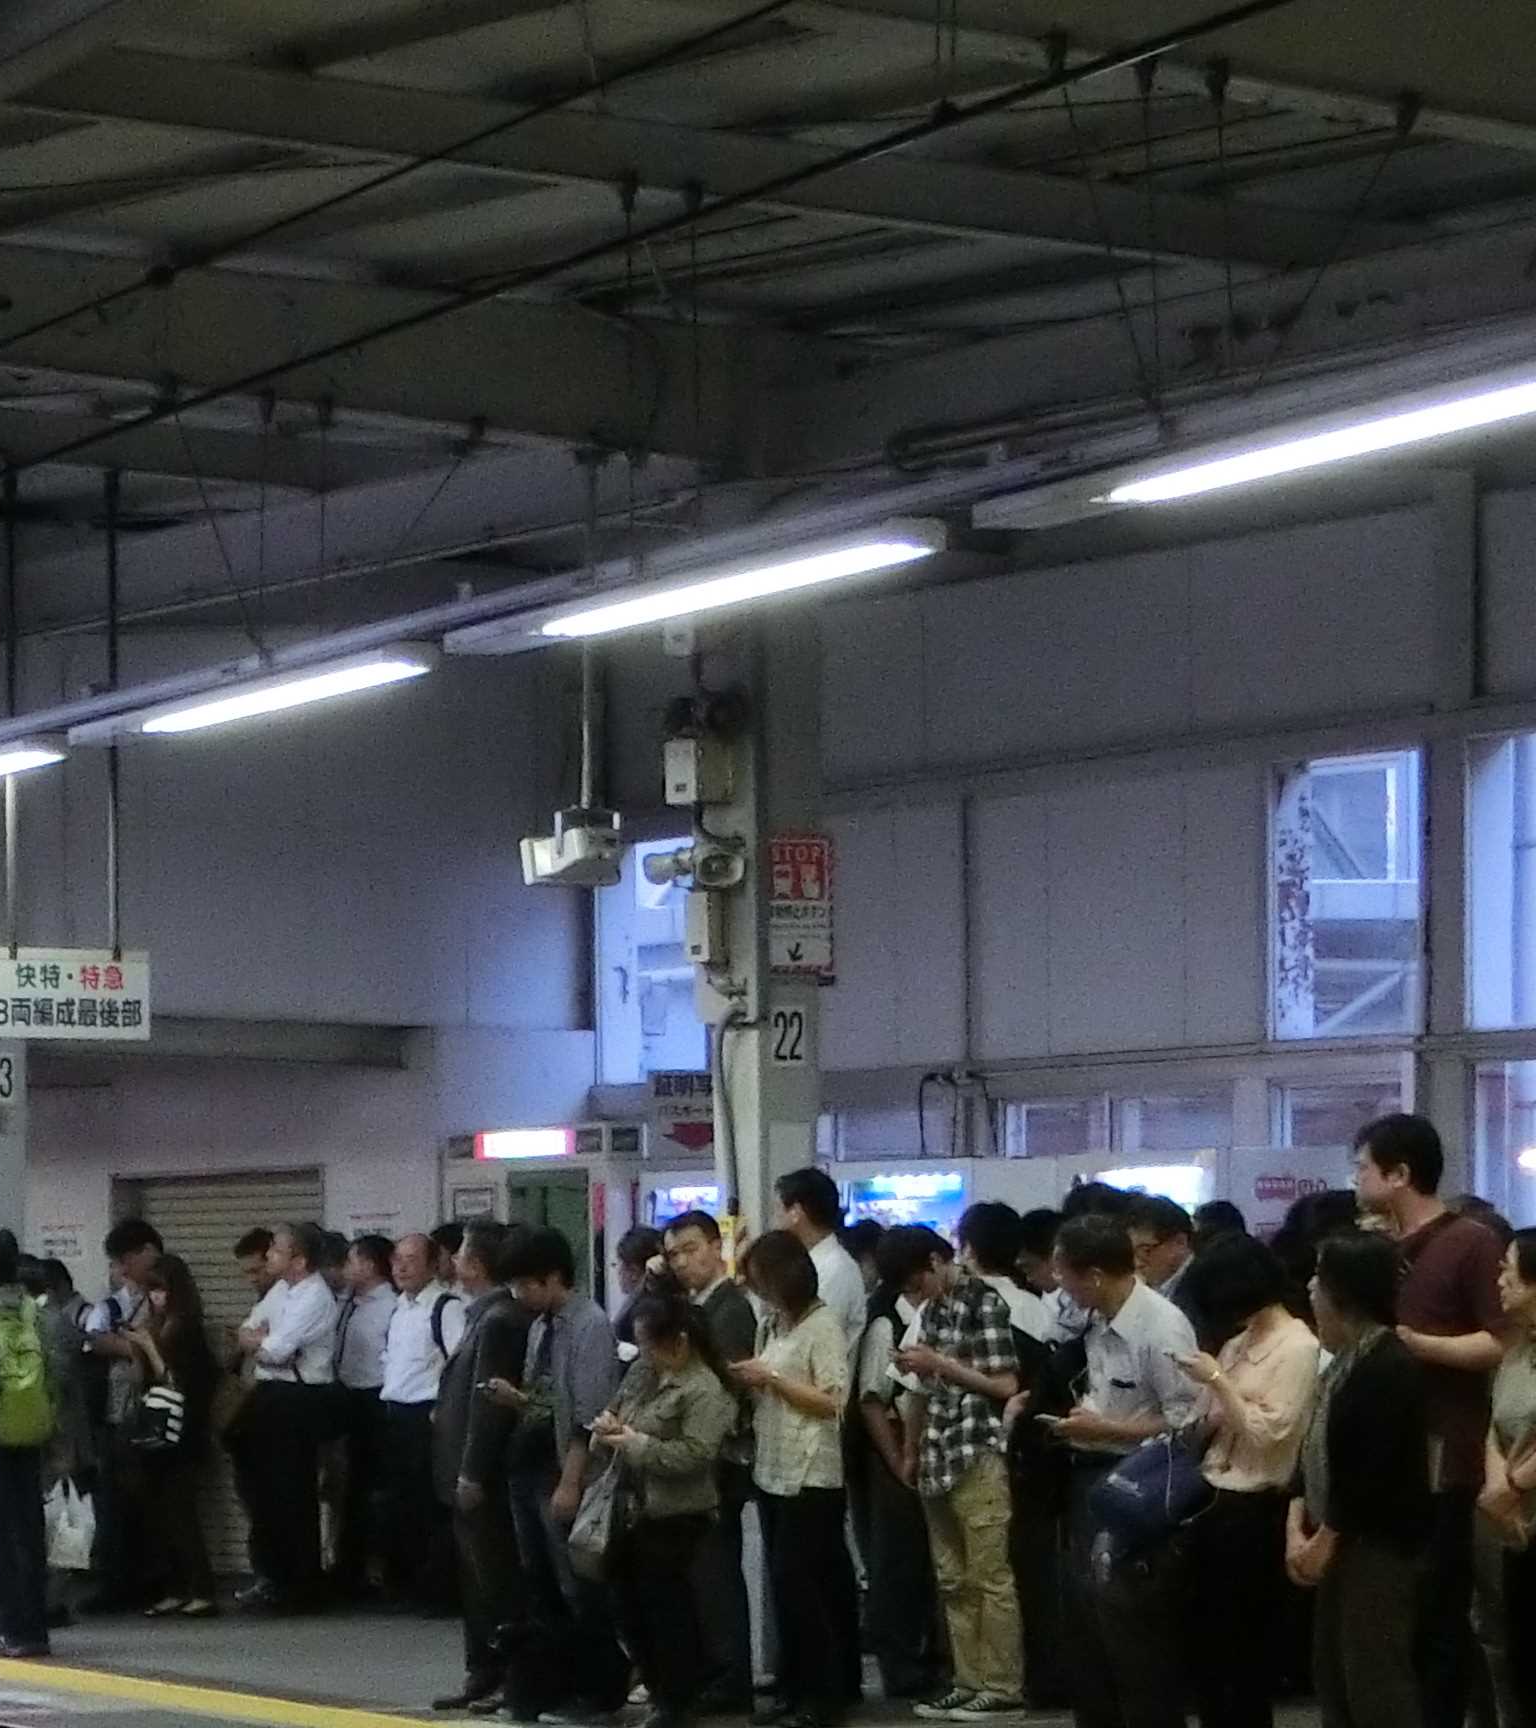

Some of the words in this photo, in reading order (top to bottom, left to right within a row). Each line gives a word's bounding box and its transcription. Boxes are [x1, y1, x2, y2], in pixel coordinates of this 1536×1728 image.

[15, 963, 124, 991] 快特・特急
[773, 1011, 803, 1061] 22
